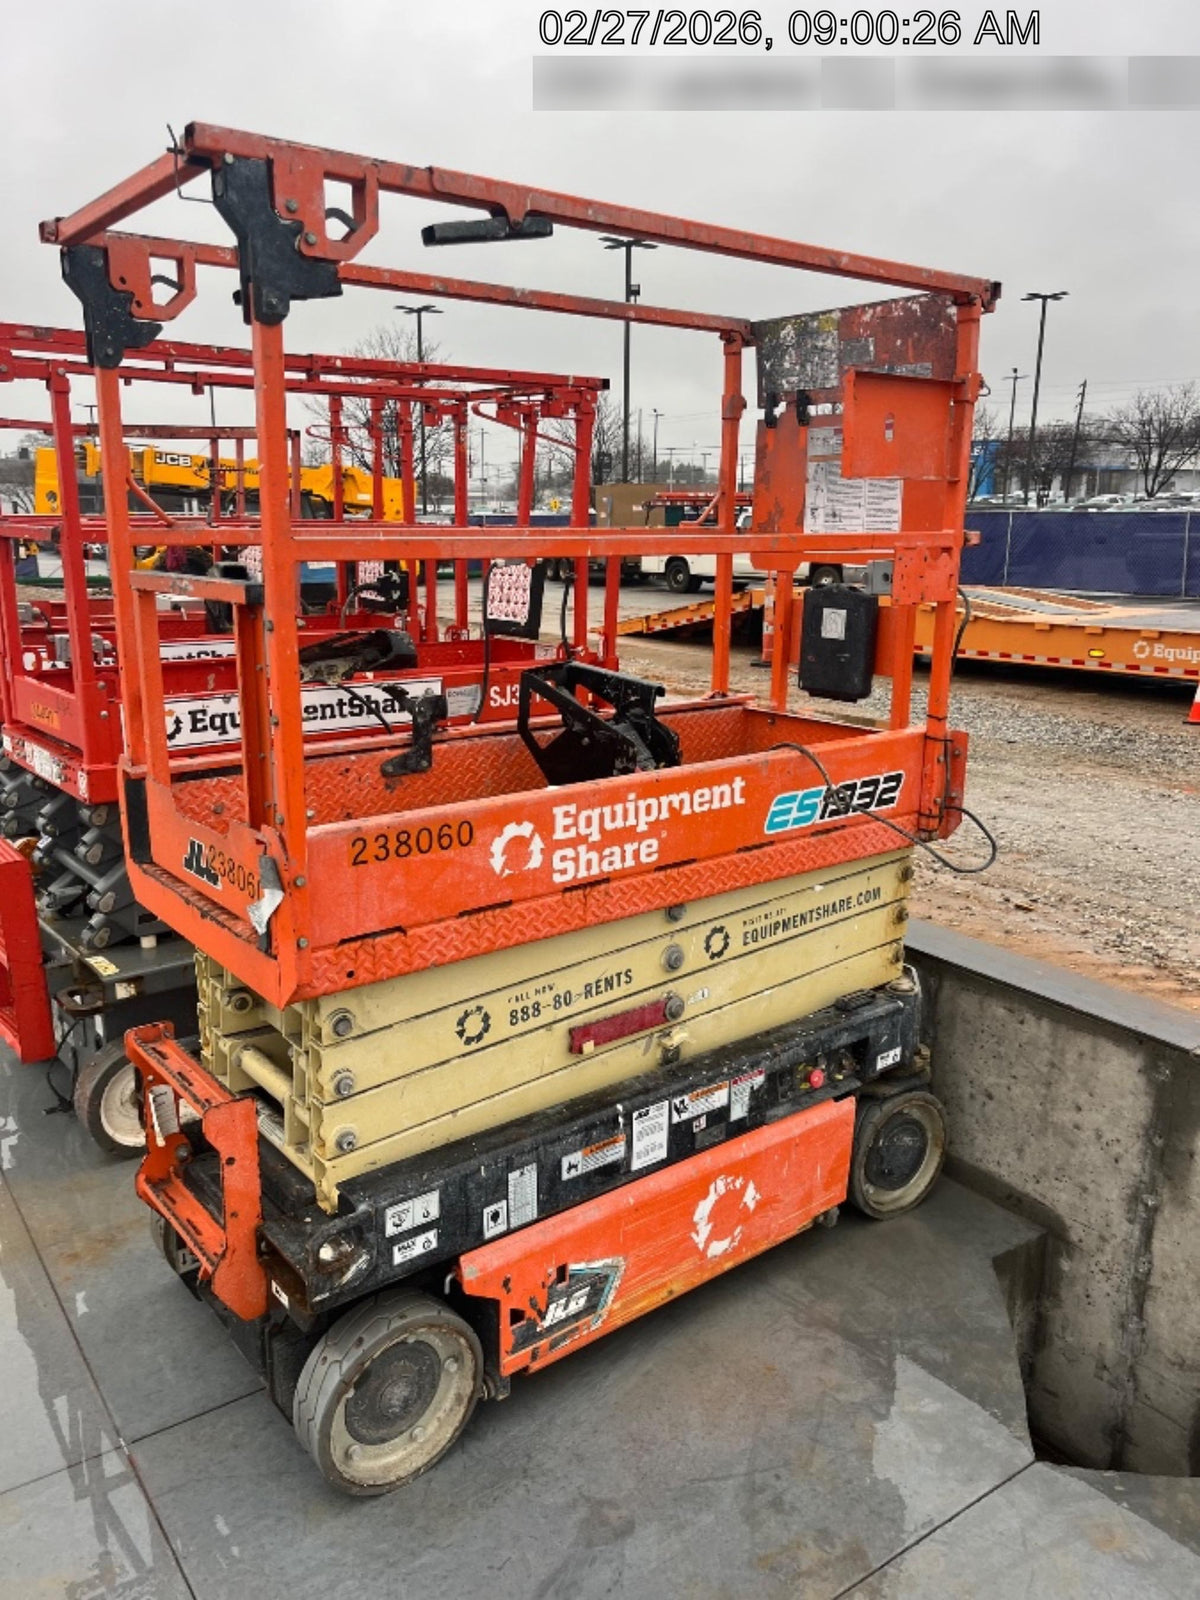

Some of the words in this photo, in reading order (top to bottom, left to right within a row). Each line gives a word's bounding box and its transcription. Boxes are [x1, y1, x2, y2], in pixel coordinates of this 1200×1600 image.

[155, 453, 193, 468] JCB
[552, 776, 747, 842] Equipment
[350, 820, 474, 867] 238060
[552, 838, 660, 884] Share
[742, 886, 881, 947] EQUIPMENTSHARE.COM
[508, 968, 633, 1027] 888-80-RENTS
